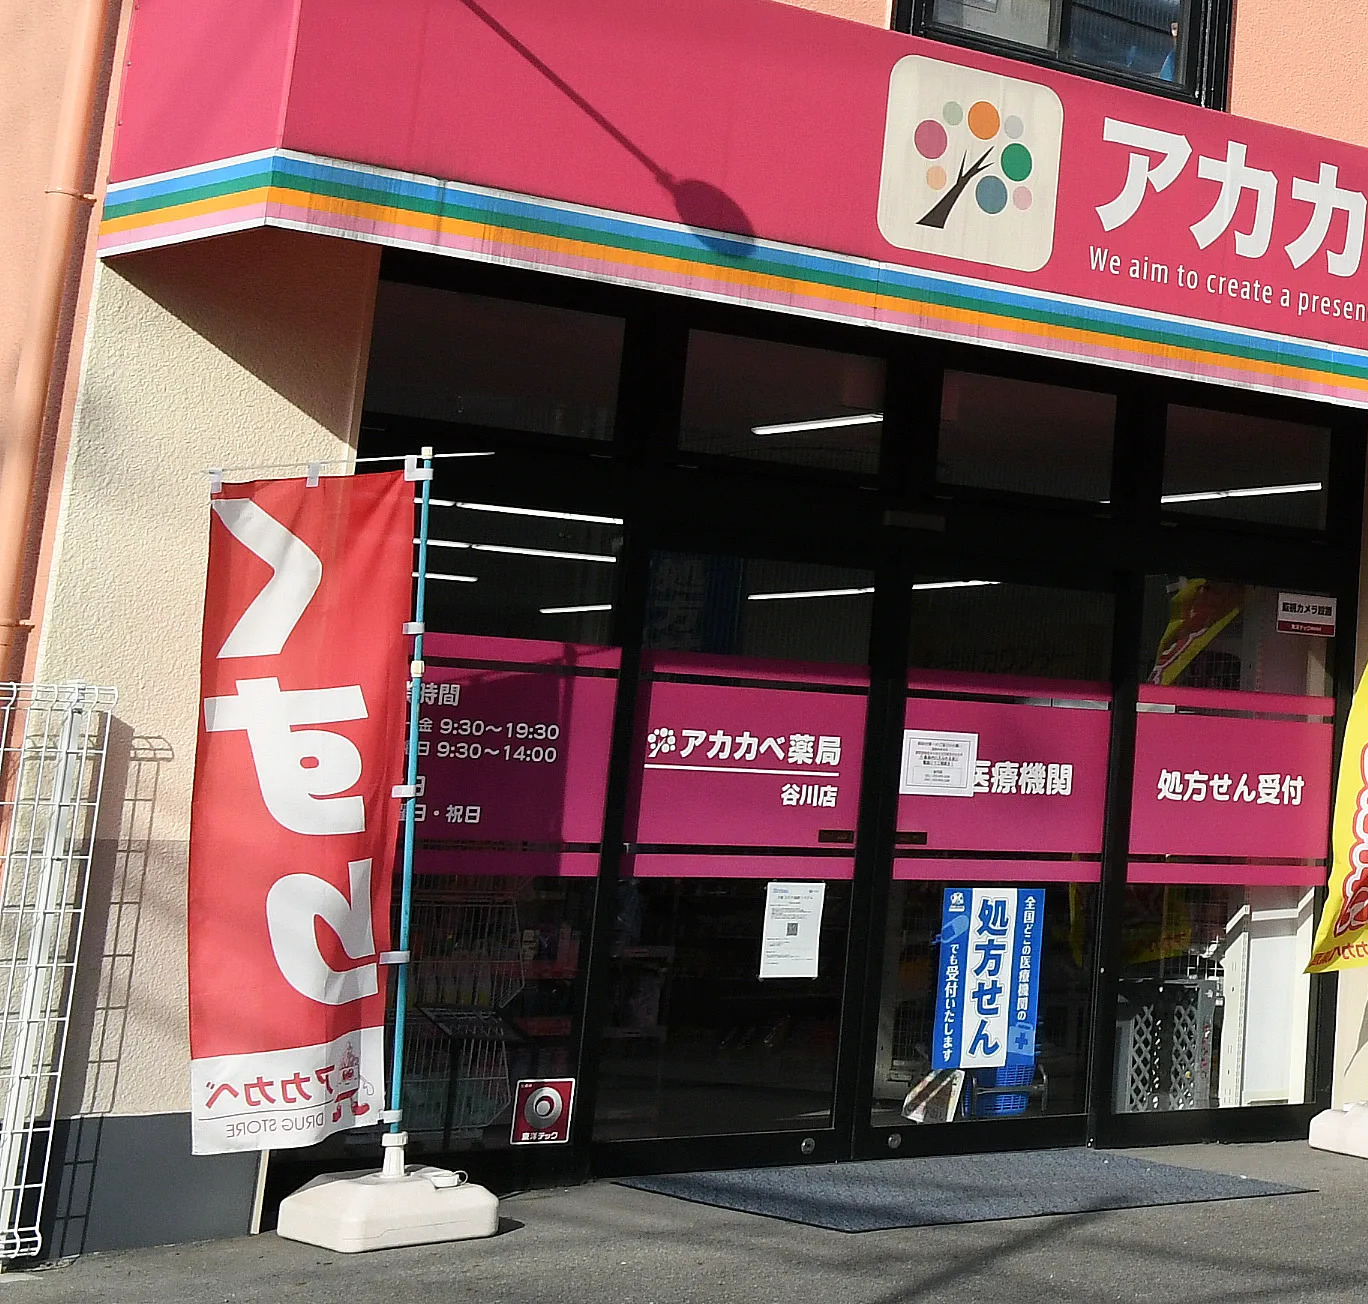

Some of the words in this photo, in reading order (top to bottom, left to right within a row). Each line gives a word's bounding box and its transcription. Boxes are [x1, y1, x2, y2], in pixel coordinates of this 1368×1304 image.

[1088, 245, 1122, 276] We
[1128, 256, 1169, 284] aim
[1176, 264, 1200, 290] to
[1206, 271, 1273, 306] create
[1279, 288, 1291, 307] a
[679, 728, 842, 766] アカカベ薬局
[780, 783, 838, 808] 谷川店
[1157, 769, 1305, 806] 処方せん受付
[967, 898, 1010, 1057] 処方せん
[1016, 896, 1036, 1021] 全国どこの医療機関の
[942, 943, 960, 1062] でも受付いたします
